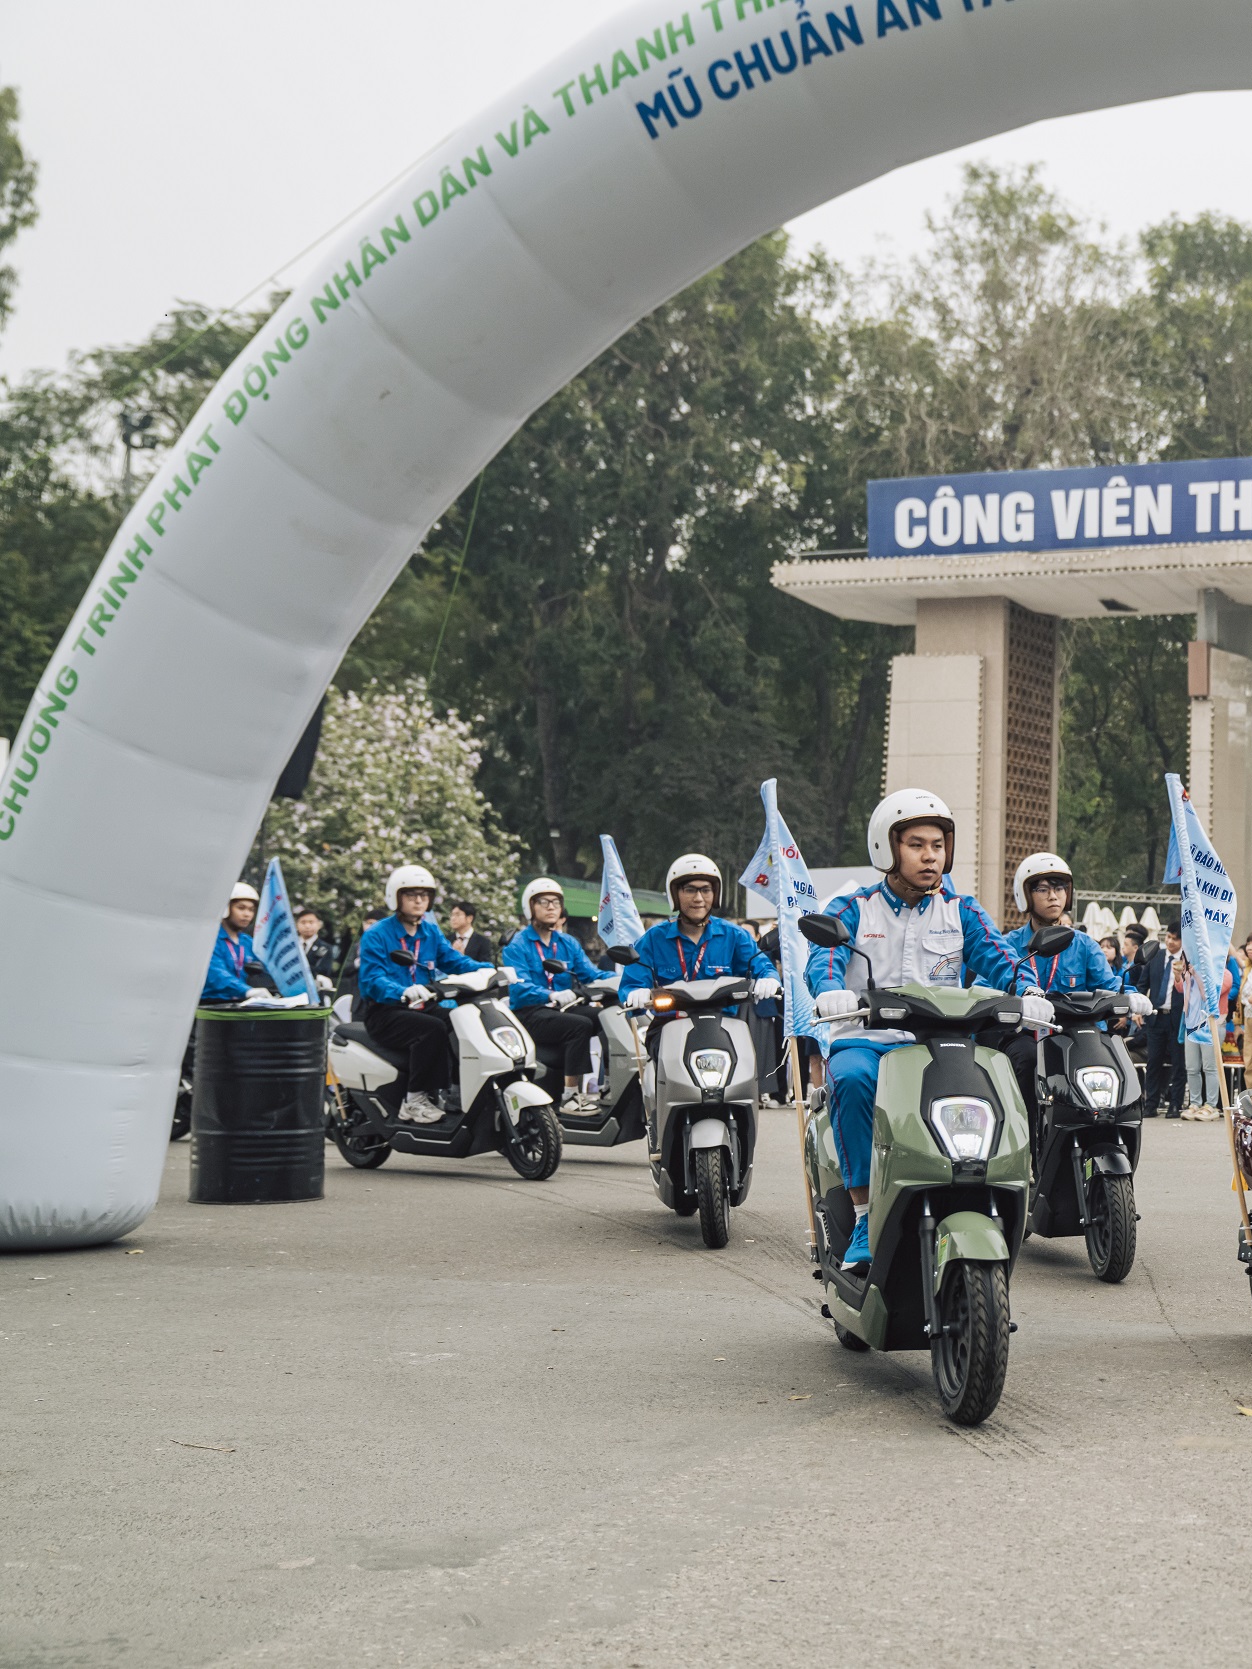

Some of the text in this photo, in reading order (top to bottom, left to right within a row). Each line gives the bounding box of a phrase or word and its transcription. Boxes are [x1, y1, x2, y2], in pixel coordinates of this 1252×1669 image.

[636, 0, 942, 140] MŨ CHUẨN AN
[73, 532, 153, 657] TRÌNH
[222, 316, 310, 426] ĐỘNG
[310, 214, 411, 324] NHÂN
[412, 145, 493, 228] DÂN
[494, 104, 550, 158] VÀ
[553, 12, 695, 117] THANH
[895, 486, 1035, 549] CÔNG
[1050, 475, 1173, 540] VIÊN
